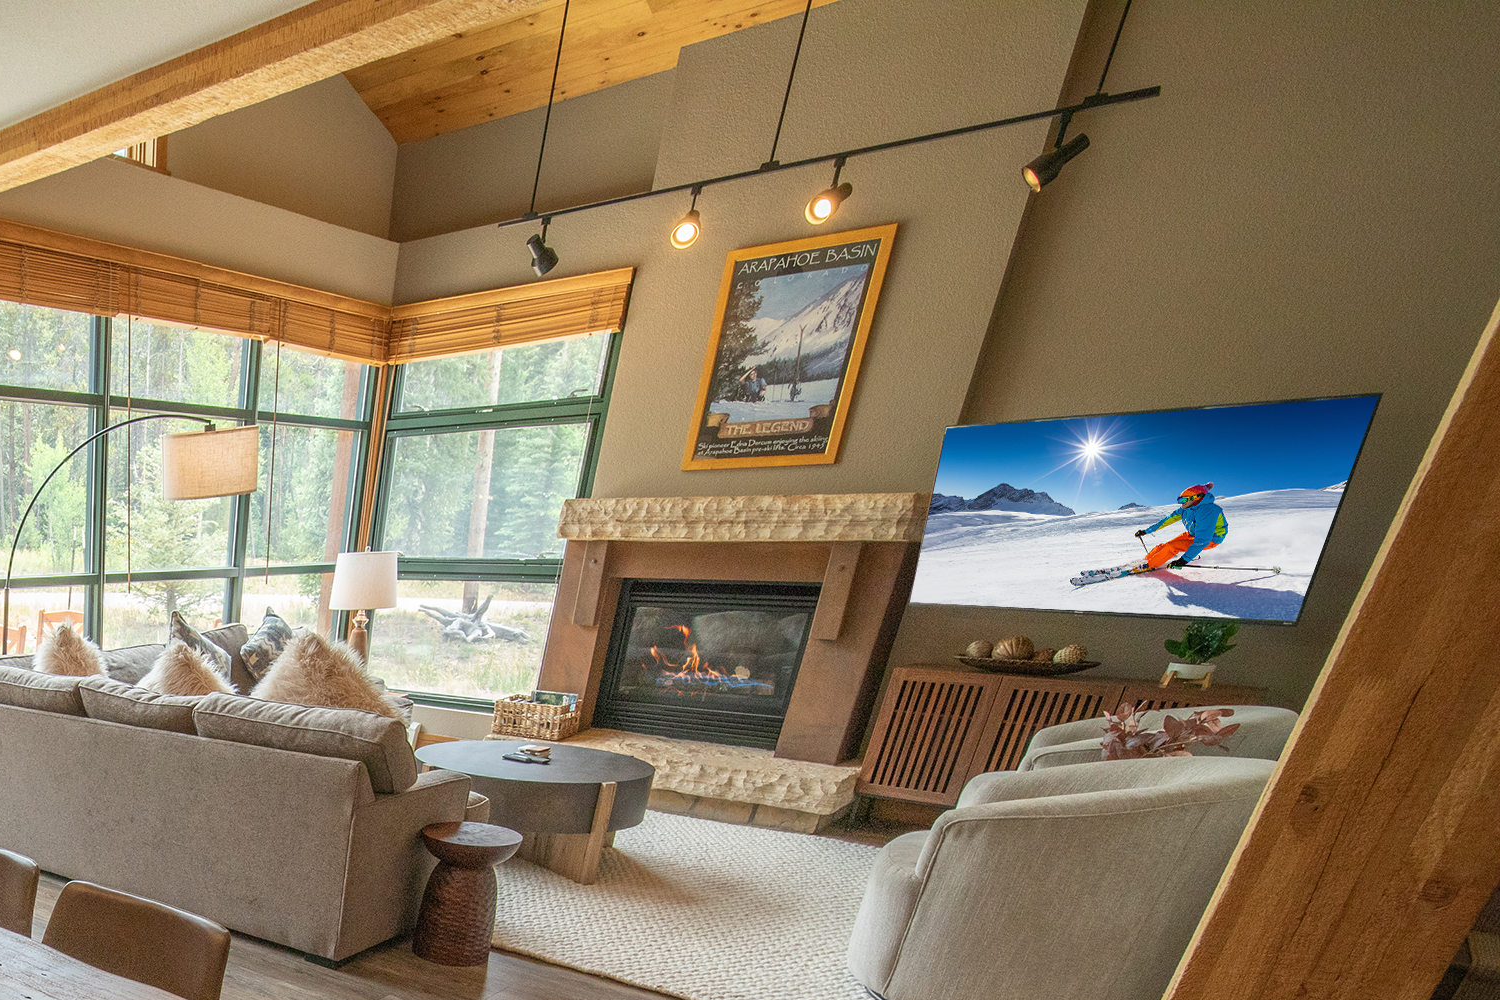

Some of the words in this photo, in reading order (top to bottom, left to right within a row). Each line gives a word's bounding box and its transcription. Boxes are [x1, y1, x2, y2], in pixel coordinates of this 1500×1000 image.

[737, 250, 821, 275] ARAPAHOE
[825, 244, 878, 263] BASIN
[736, 264, 868, 290] COLORADO
[725, 425, 752, 435] THE
[755, 420, 810, 434] LEGEND
[698, 442, 708, 451] Ski
[708, 443, 731, 451] pioneer
[730, 440, 748, 448] Edna
[772, 437, 798, 446] enjoying
[703, 448, 733, 456] Arapahoe
[733, 446, 751, 454] Basin
[787, 443, 807, 451] Circa
